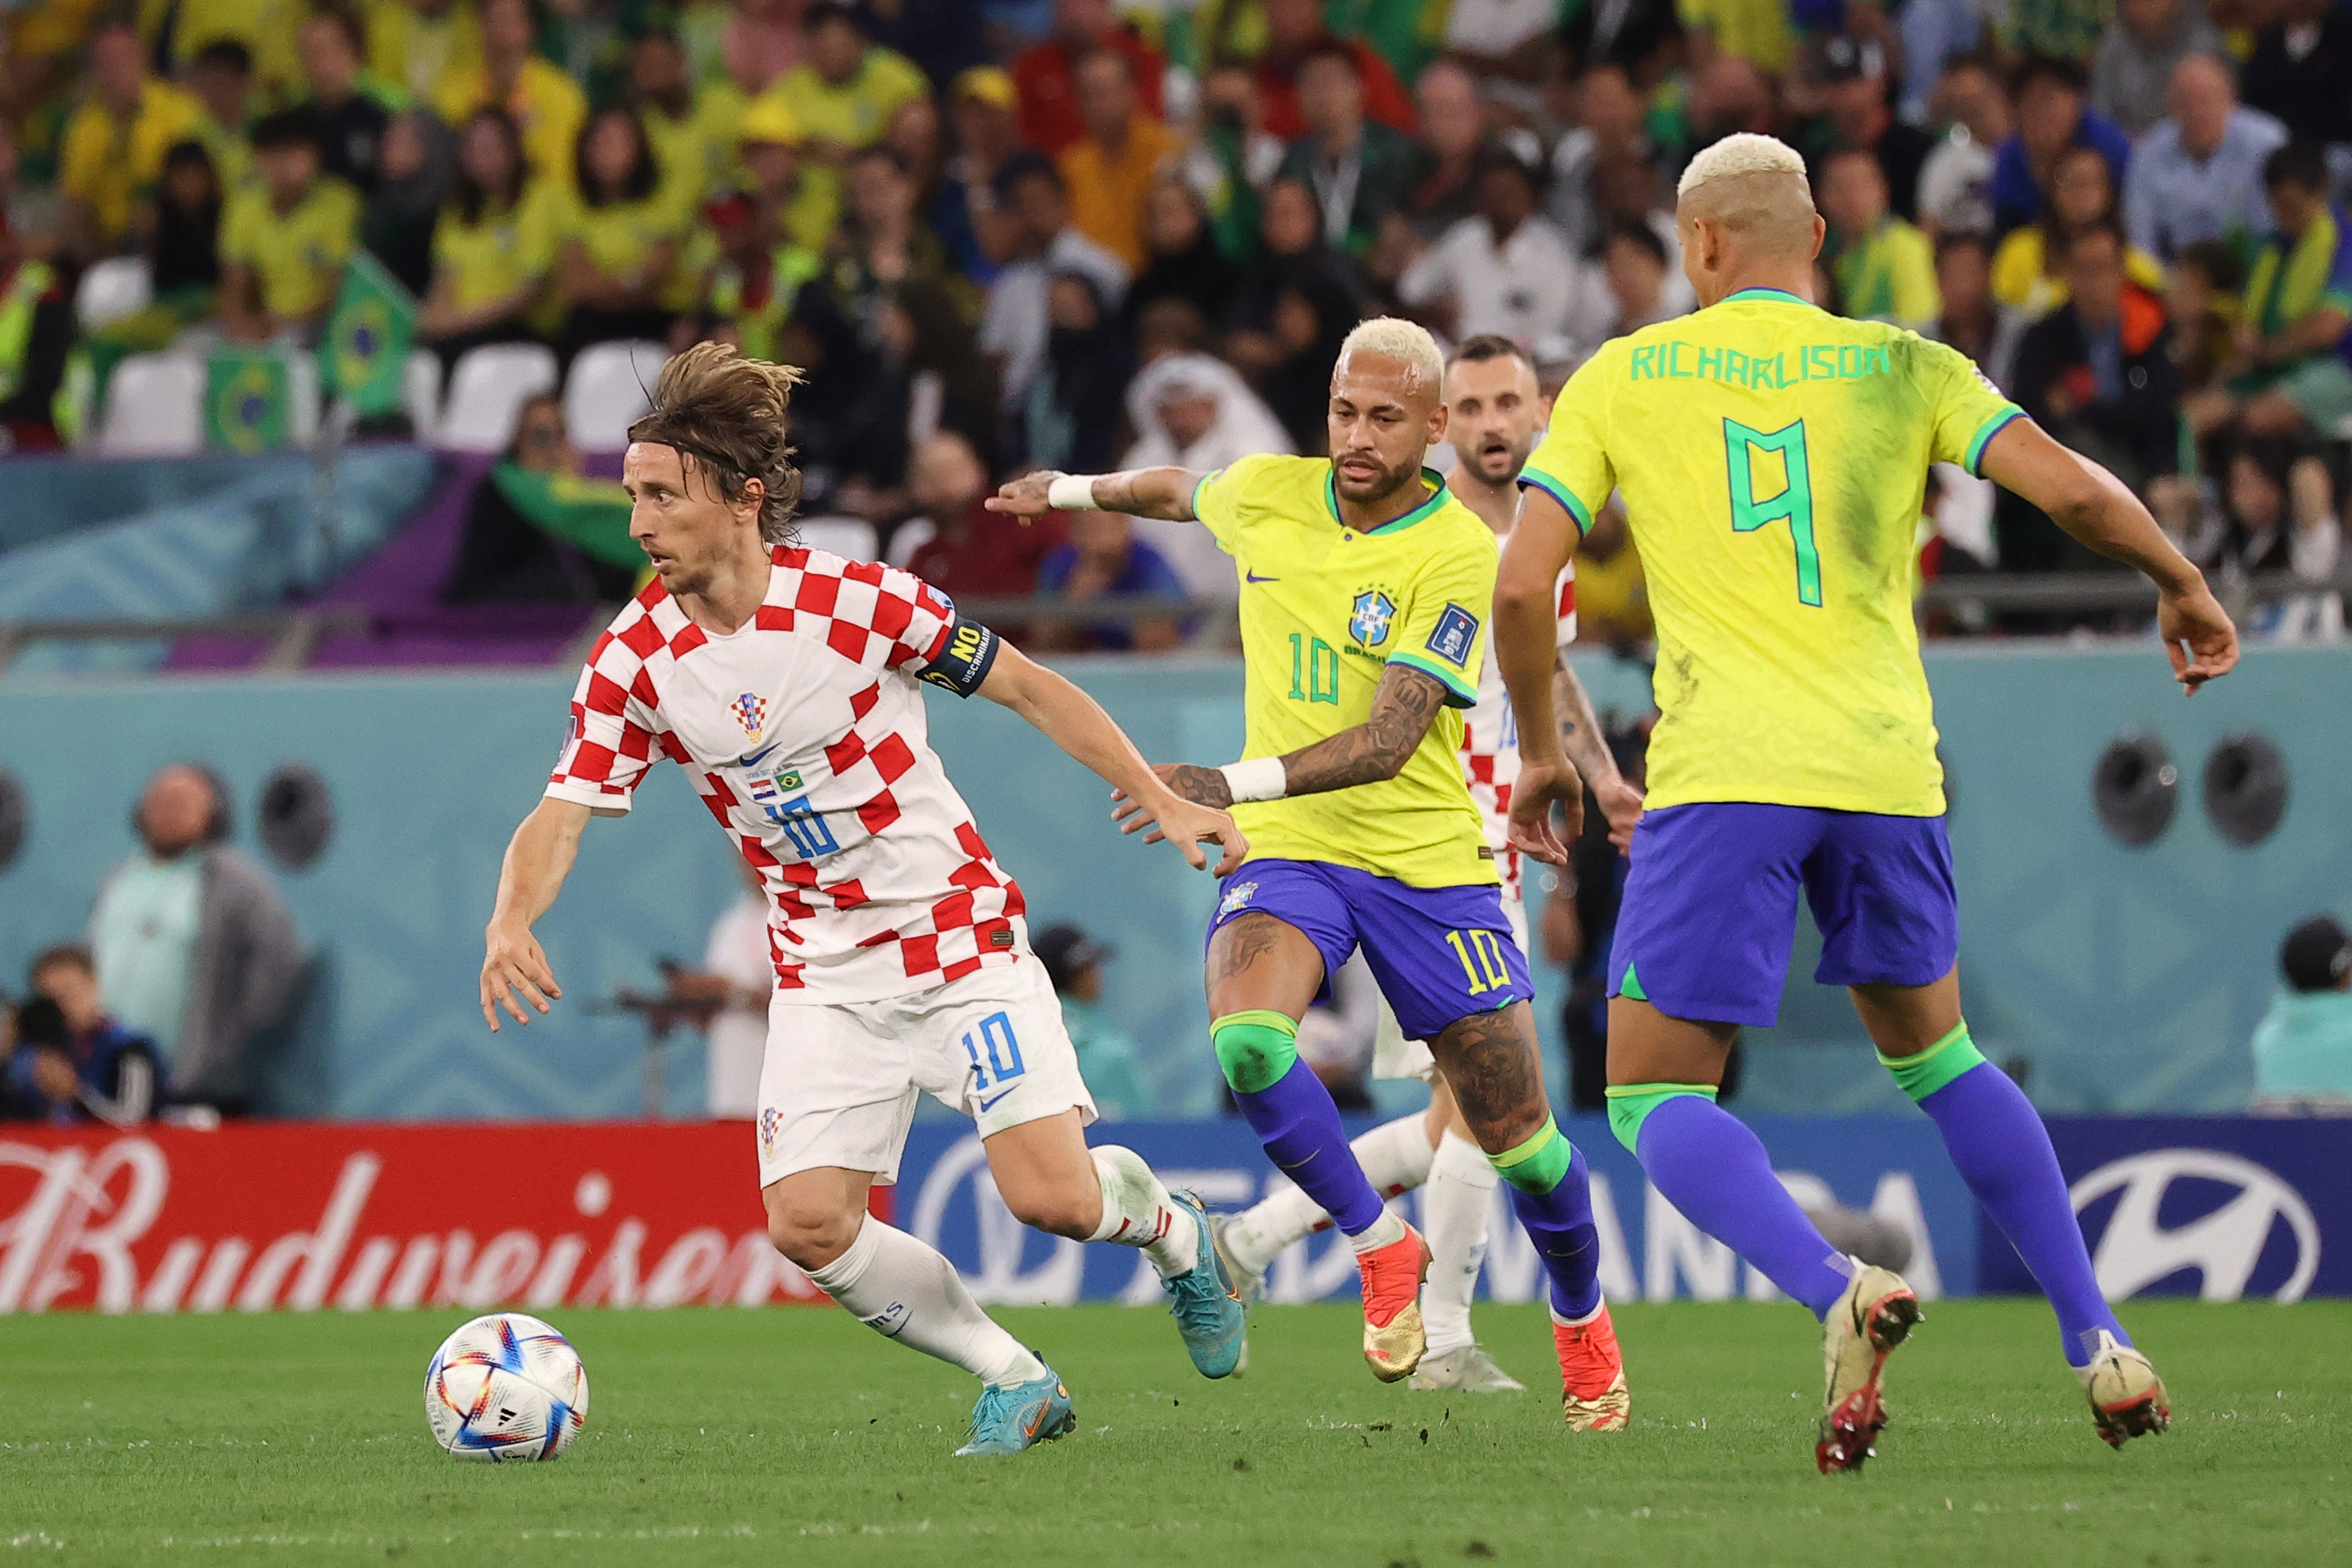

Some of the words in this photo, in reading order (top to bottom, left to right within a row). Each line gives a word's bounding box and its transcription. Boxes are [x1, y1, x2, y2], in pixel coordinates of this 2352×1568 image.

[1631, 341, 1891, 390] RICHARLISON
[1723, 416, 1822, 608] 9
[949, 625, 982, 664] NO
[1363, 613, 1379, 623] CBF
[1288, 633, 1339, 706] 10
[763, 795, 841, 860] 10
[1444, 929, 1513, 997] 10
[961, 1011, 1025, 1091] 10
[0, 1137, 819, 1312] Budweiser
